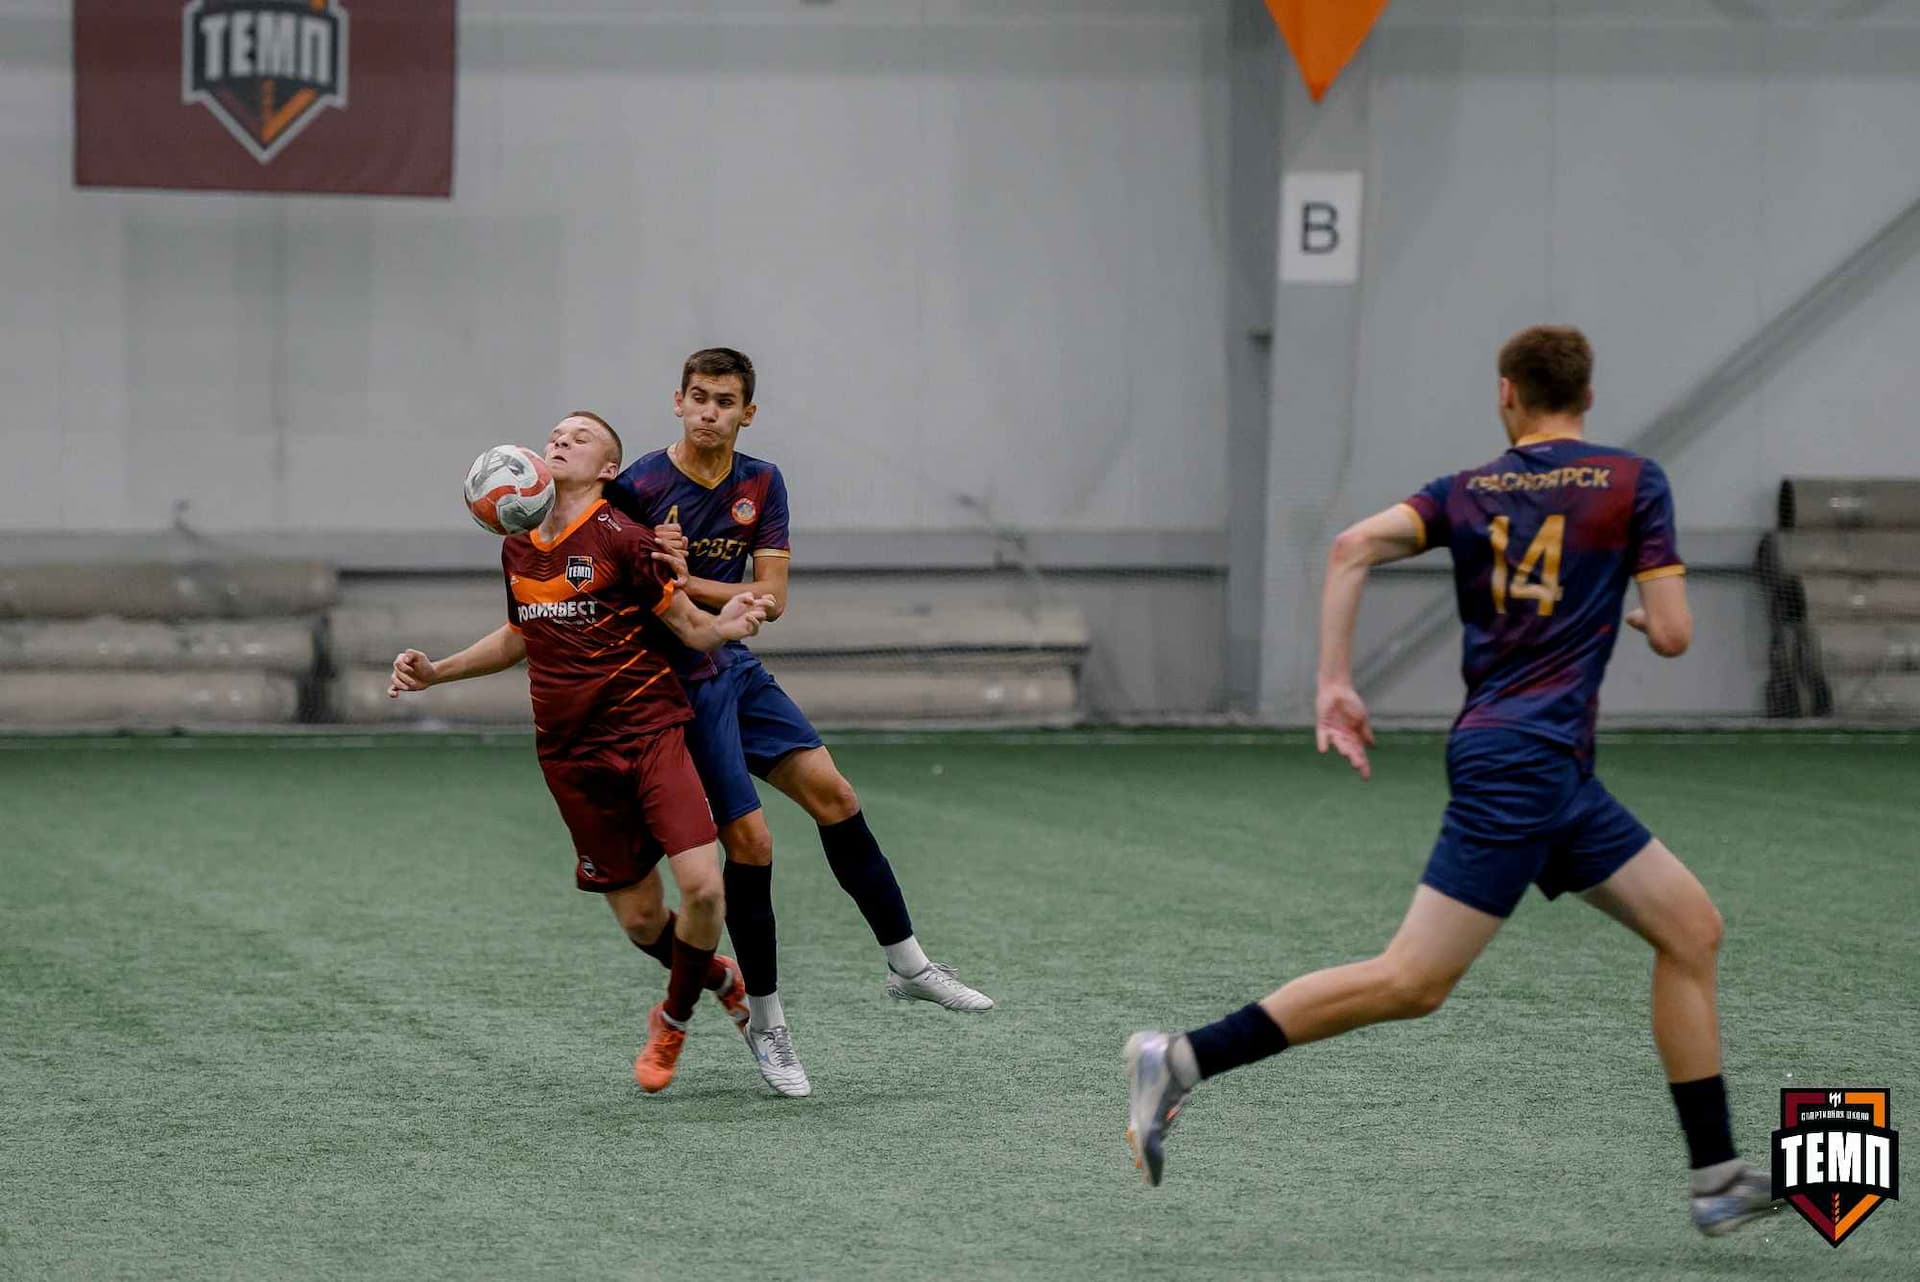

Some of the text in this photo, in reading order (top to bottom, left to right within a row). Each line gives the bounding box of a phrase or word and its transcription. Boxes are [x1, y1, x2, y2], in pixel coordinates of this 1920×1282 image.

[201, 10, 333, 85] ТЕМП
[690, 537, 748, 561] СВЕТ
[1488, 514, 1566, 617] 14
